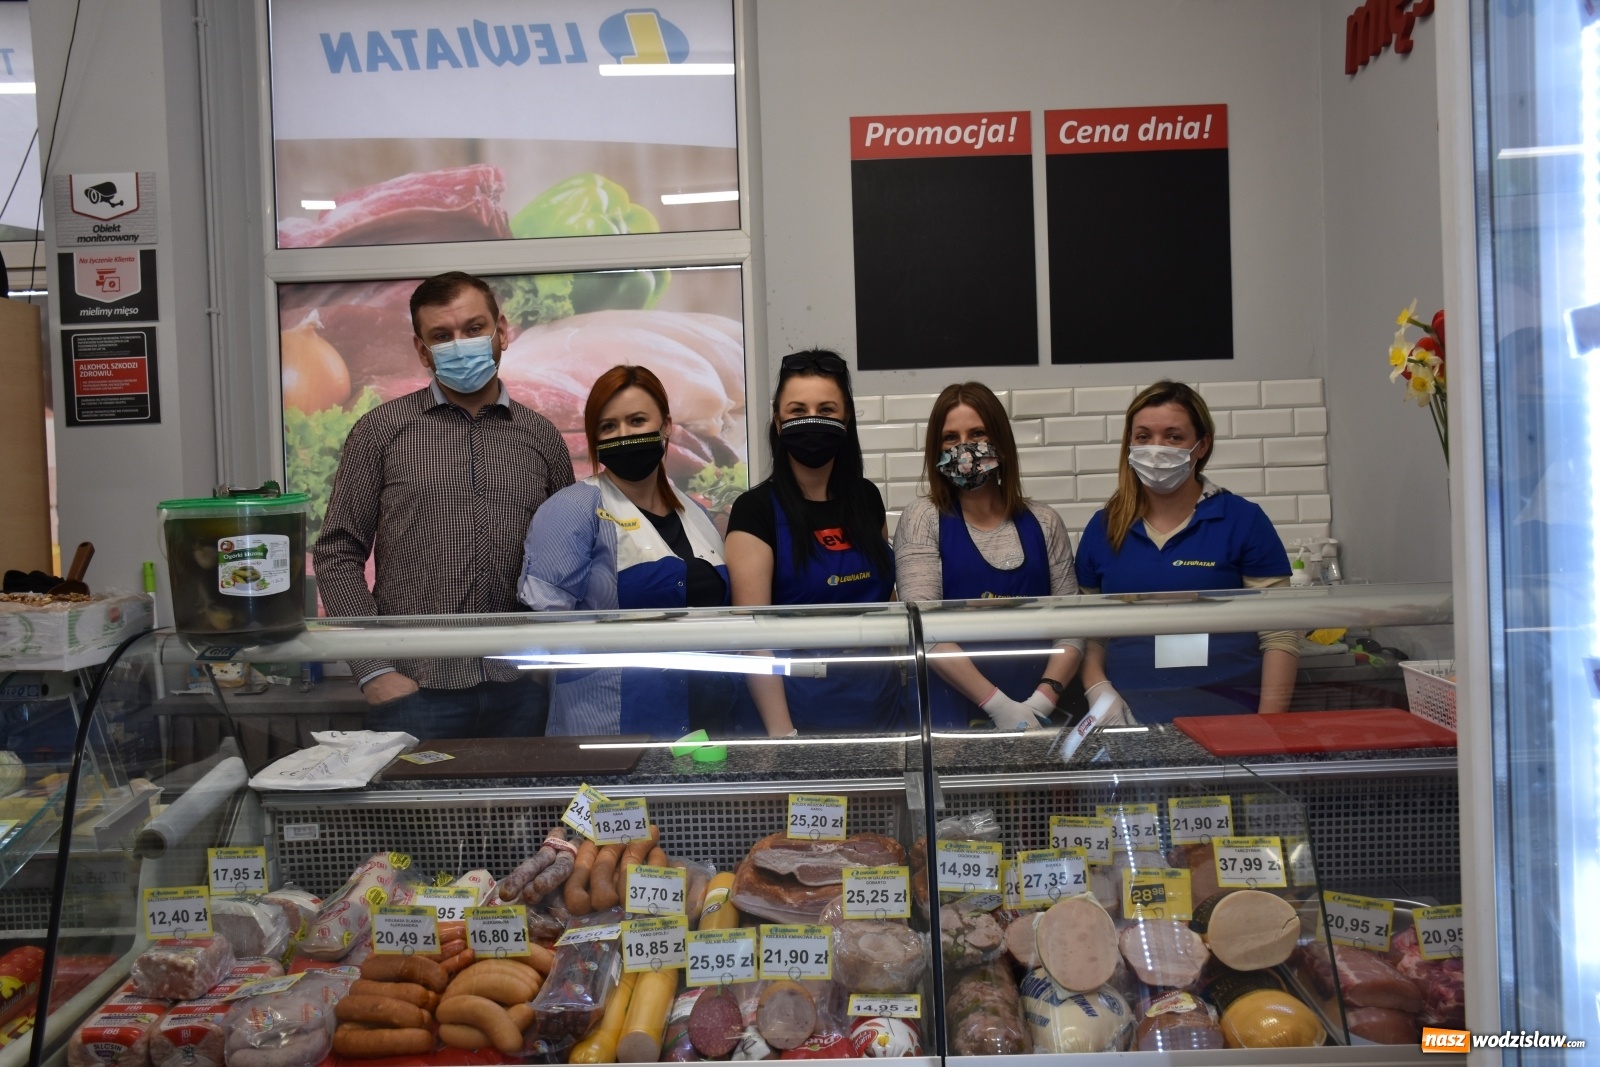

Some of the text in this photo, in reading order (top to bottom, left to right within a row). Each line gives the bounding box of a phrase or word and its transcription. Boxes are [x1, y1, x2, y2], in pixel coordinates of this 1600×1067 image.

[865, 116, 1017, 150] Promocja!
[1058, 113, 1213, 145] Cena dnia!
[92, 224, 121, 233] Obiekt
[77, 233, 139, 243] monitorowany
[89, 256, 113, 265] życzenie
[80, 306, 139, 317] mielimy mięso
[79, 362, 138, 371] ALKOHOL SZKODZI
[80, 370, 114, 378] ZDROWIU.
[839, 571, 871, 583] LEWIATAN
[595, 817, 647, 834] 18,20 zł
[790, 814, 844, 828] 25,20 zł
[1172, 815, 1229, 832] 21,90 zł
[1144, 823, 1156, 836] zł
[1096, 837, 1109, 850] zł
[939, 861, 999, 878] 14,99 zł
[1219, 857, 1263, 873] 37,99
[213, 867, 265, 883] 17,95 zł
[1023, 869, 1087, 890] 27,35 zł
[630, 886, 684, 902] 37,70 zł
[846, 889, 908, 906] 25,25 zł
[149, 907, 209, 927] 12,40 zł
[1325, 913, 1389, 937] 20,95 zł
[375, 931, 437, 946] 20,49 zł
[470, 928, 527, 946] 16,80 zł
[1421, 927, 1463, 946] 20,95
[626, 938, 686, 958] 18,85 zł
[689, 952, 755, 972] 25,95 zł
[763, 948, 829, 967] 21,90 zł
[854, 1004, 899, 1013] 14,95
